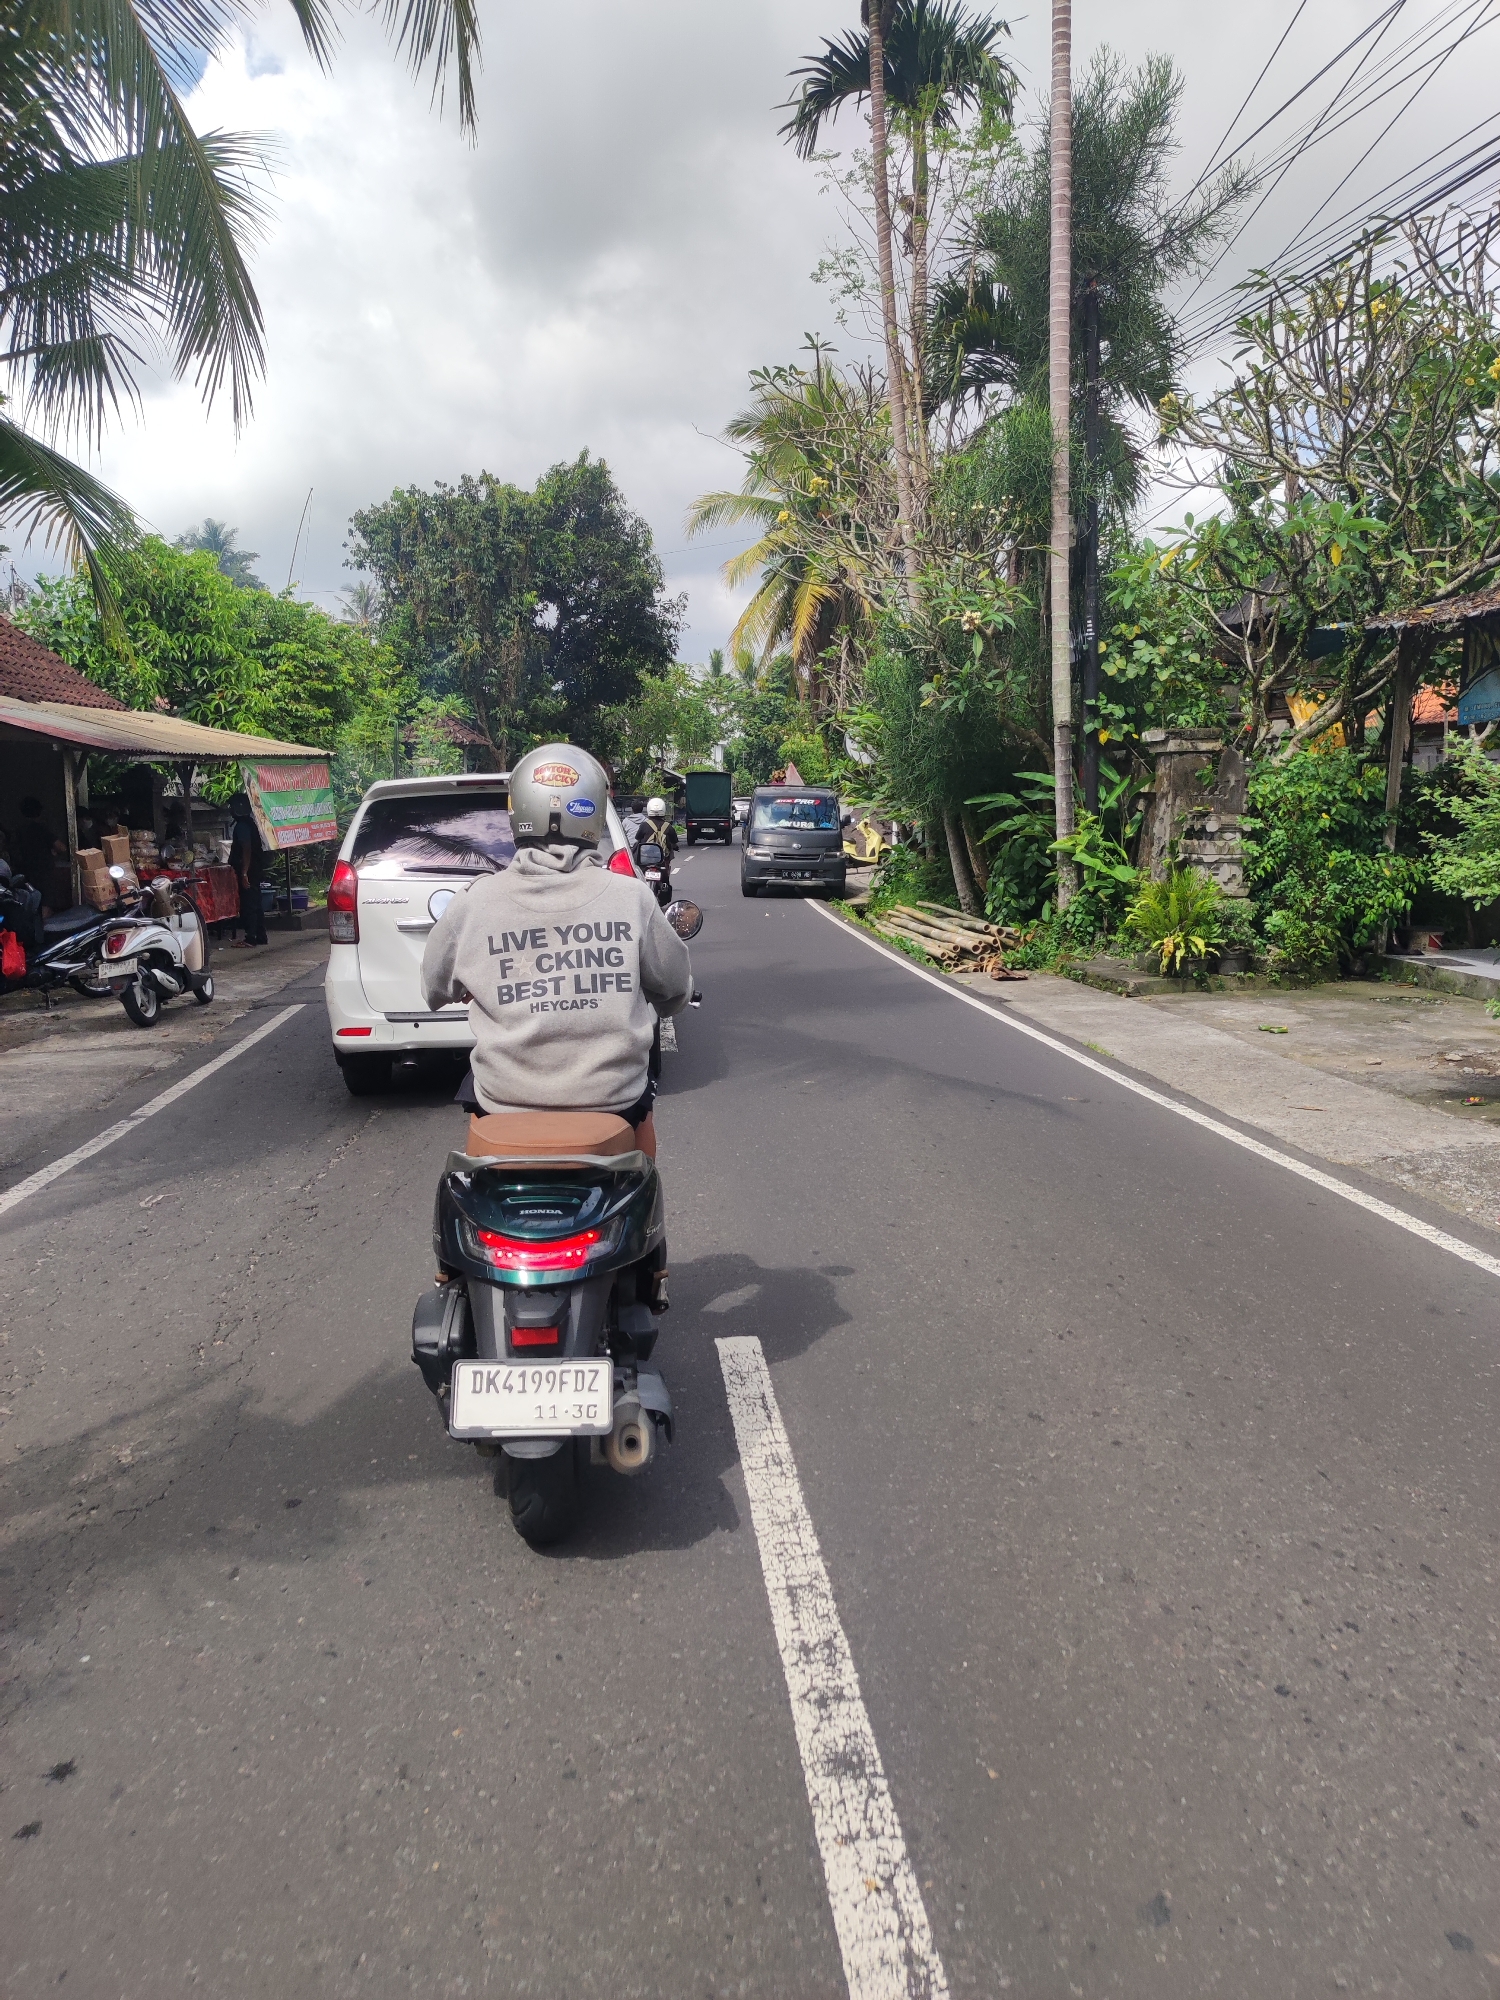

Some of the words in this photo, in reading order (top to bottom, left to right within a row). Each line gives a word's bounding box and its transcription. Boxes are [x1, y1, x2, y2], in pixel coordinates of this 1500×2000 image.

[541, 774, 576, 786] LUCKY
[488, 928, 548, 955] LIVE
[553, 922, 633, 945] YOUR
[497, 976, 566, 1005] BEST
[574, 973, 633, 994] LIFE
